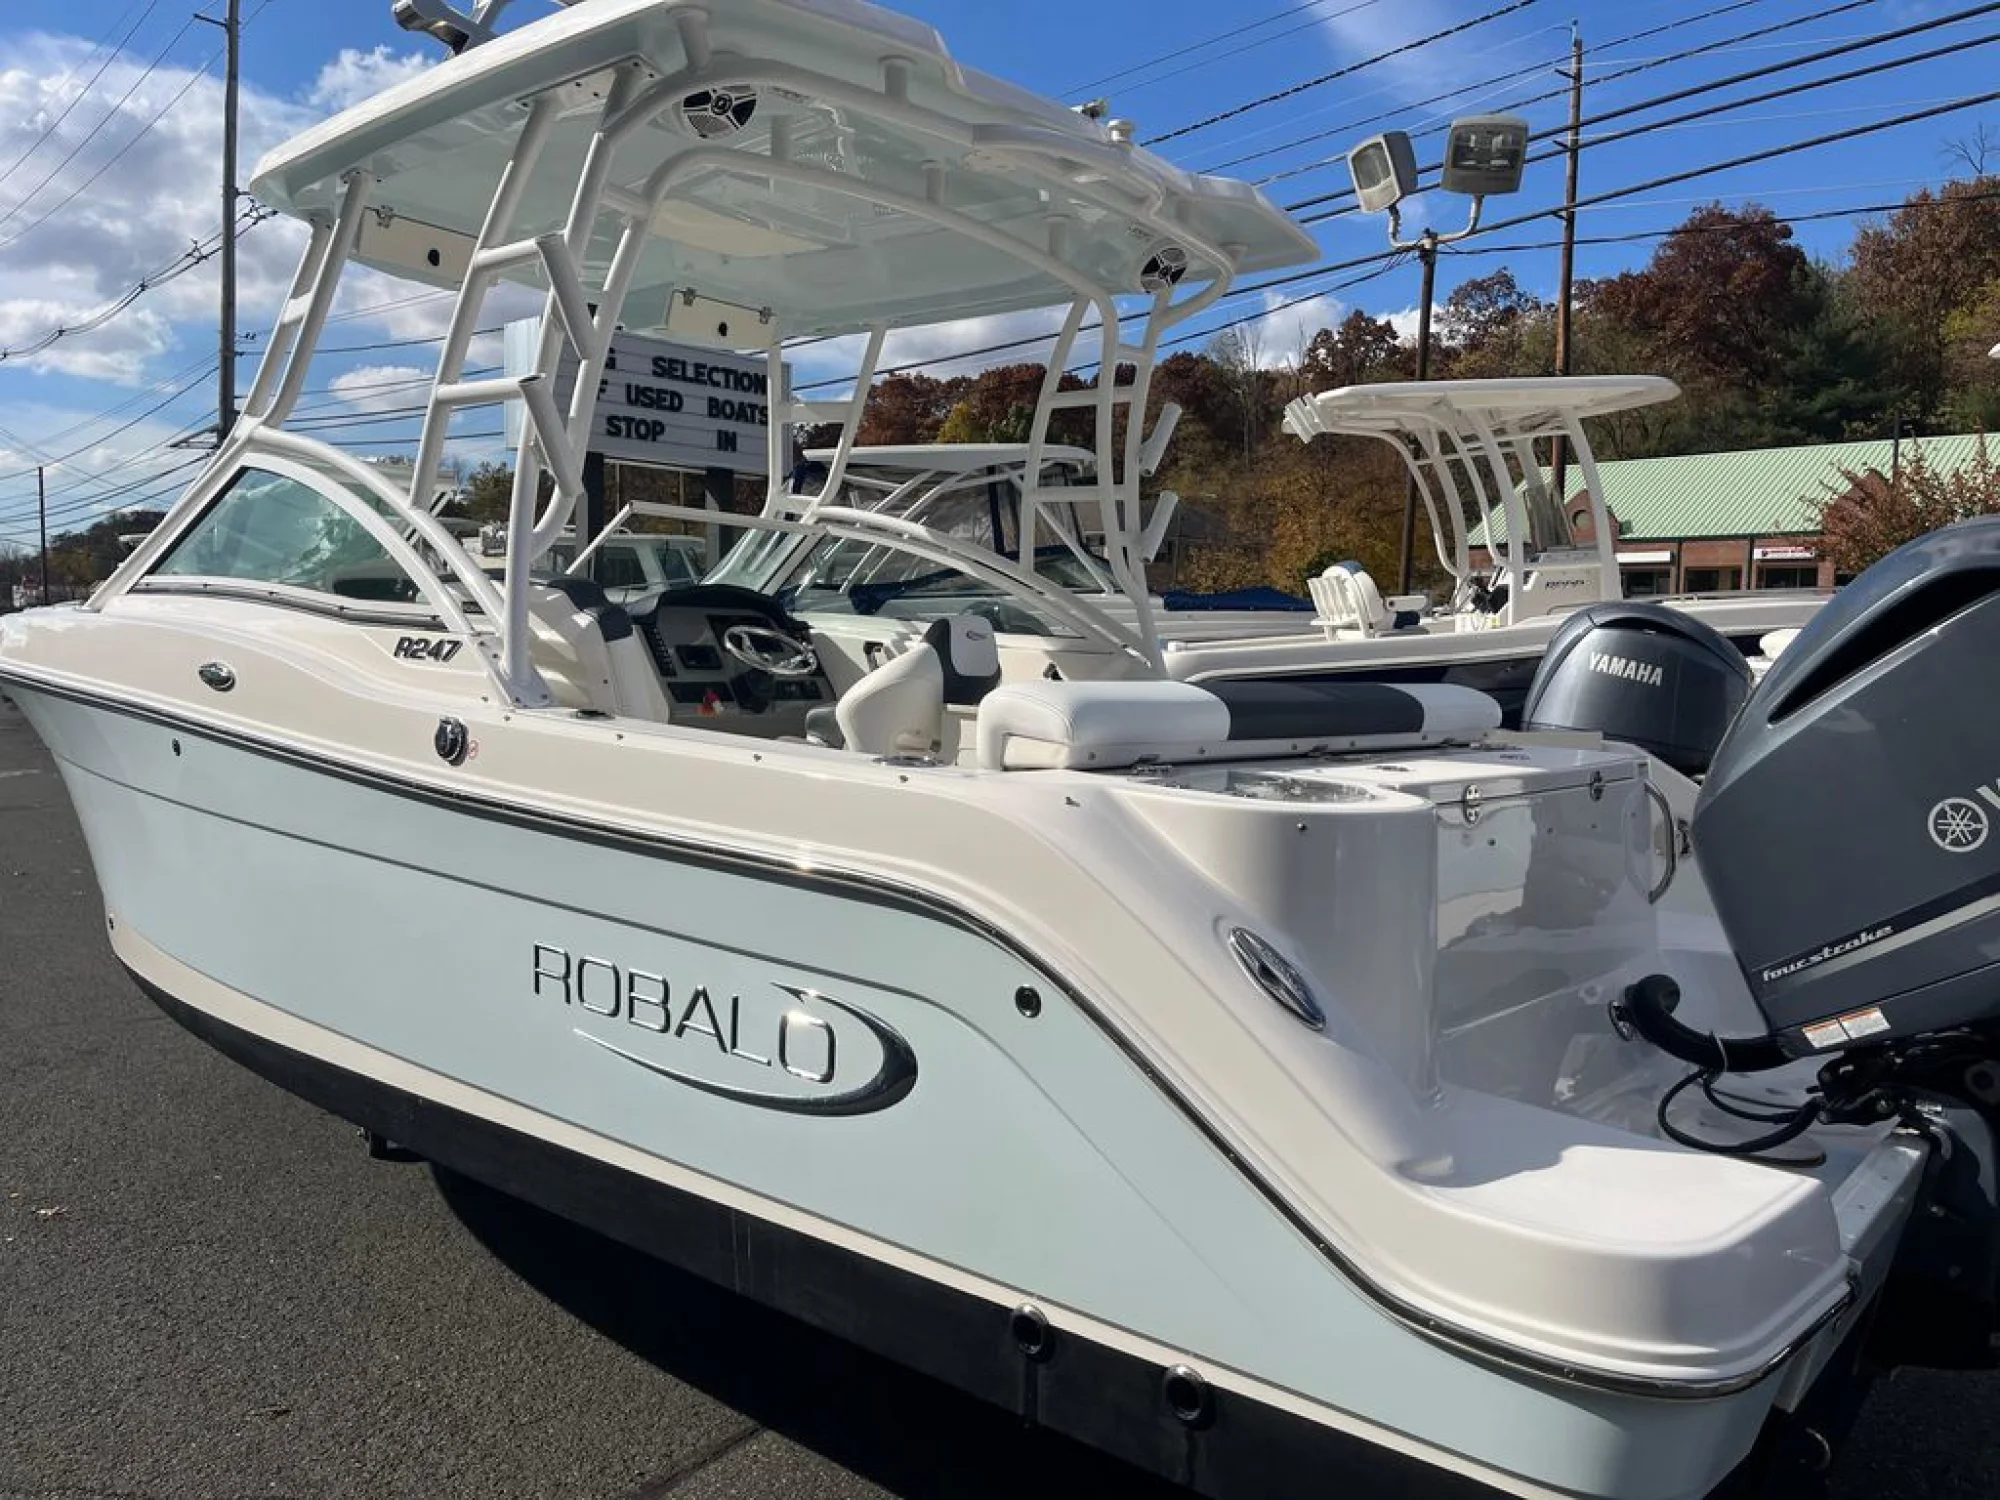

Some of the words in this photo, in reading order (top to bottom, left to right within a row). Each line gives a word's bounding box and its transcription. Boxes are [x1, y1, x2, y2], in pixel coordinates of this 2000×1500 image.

[651, 355, 767, 395] SELECTION
[625, 384, 684, 413] USED
[708, 397, 768, 426] BOATS
[606, 416, 666, 442] STOP
[717, 430, 737, 451] IN
[394, 637, 463, 662] R247
[1589, 651, 1663, 686] YAMAHA
[534, 942, 836, 1083] ROBALO
